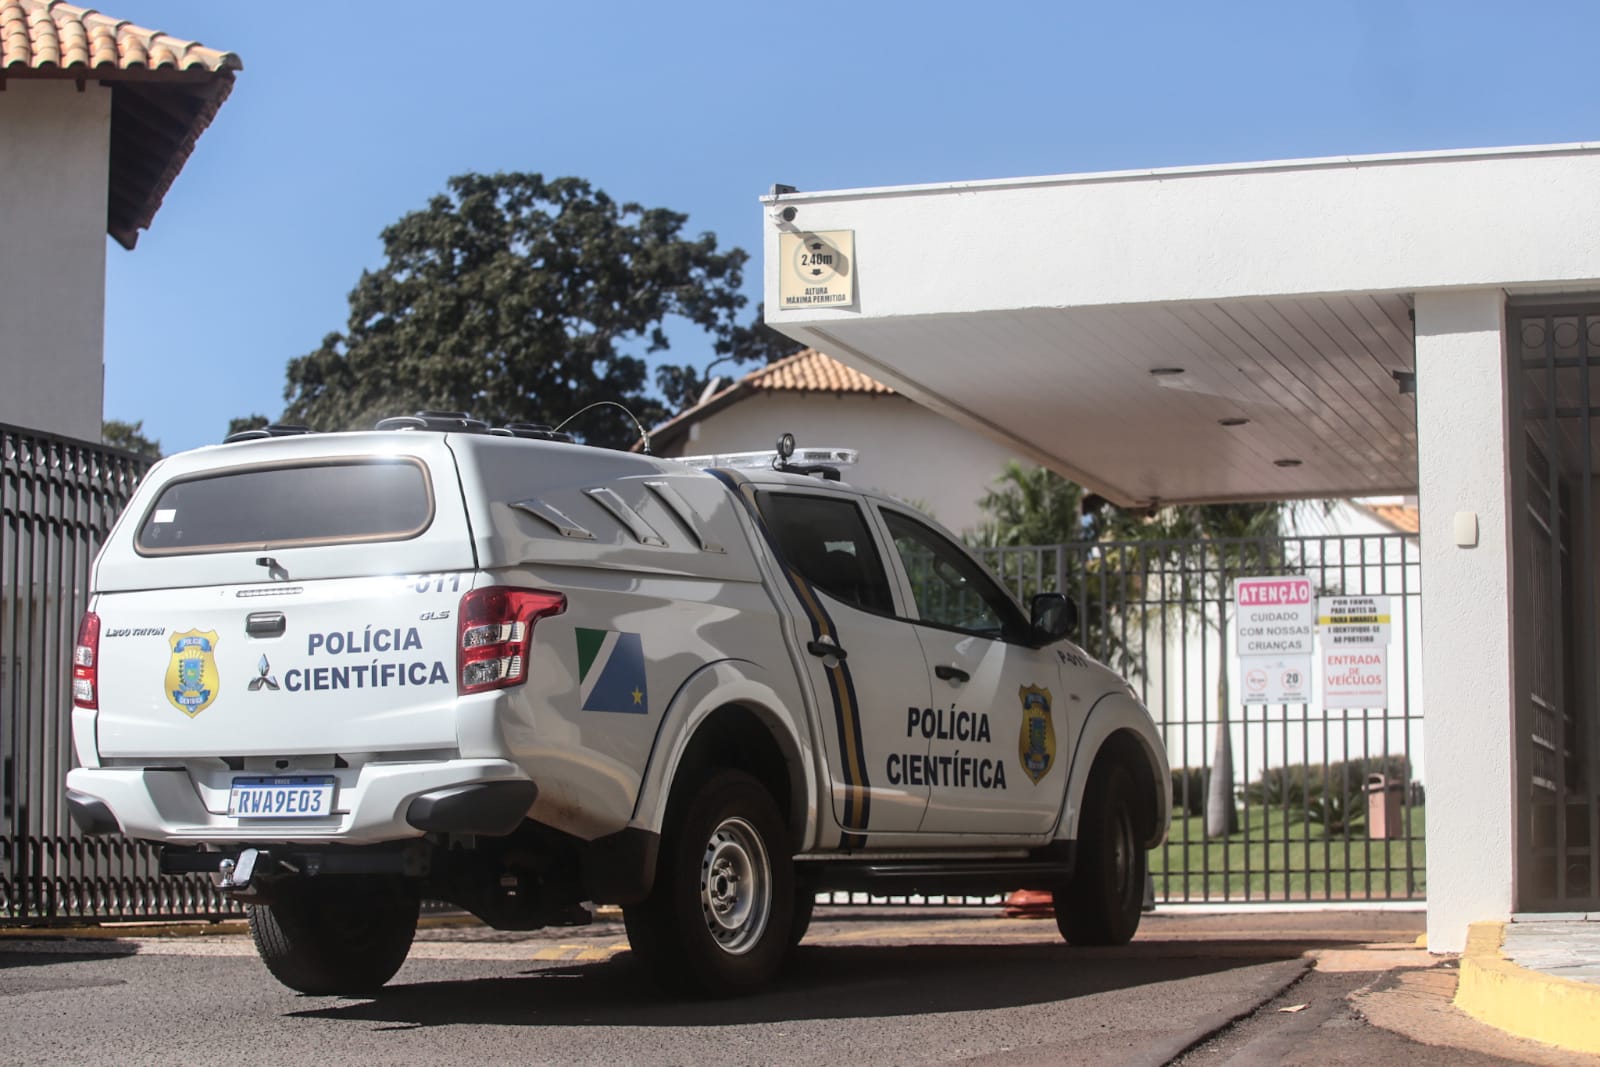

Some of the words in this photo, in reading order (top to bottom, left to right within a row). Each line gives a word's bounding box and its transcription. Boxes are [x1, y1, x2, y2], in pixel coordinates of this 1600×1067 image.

[805, 287, 828, 295] ALTURA
[786, 295, 812, 304] MÁXIMA
[813, 294, 846, 303] PERMITIDA
[1240, 583, 1308, 604] ATENÇÃO
[419, 610, 451, 621] GLS
[1347, 606, 1367, 614] ANTES
[1250, 611, 1299, 622] CUIDADO
[1330, 616, 1348, 624] FAIXA
[1349, 615, 1378, 623] AMARELA
[105, 628, 132, 637] L200
[133, 627, 165, 637] TRITON
[1240, 627, 1264, 637] COM
[1266, 626, 1310, 636] NOSSAS
[308, 624, 423, 656] POLÍCIA
[1343, 635, 1374, 643] PORTEIRO
[1248, 641, 1302, 651] CRIANÇAS
[1327, 655, 1381, 665] ENTRADA
[284, 659, 450, 692] CIENTÍFICA
[1348, 667, 1359, 675] DE
[1286, 673, 1299, 684] 20
[1327, 673, 1382, 685] VEÍCULOS
[907, 704, 991, 743] POLÍCIA
[886, 750, 1007, 789] CIENTÍFICA
[238, 789, 323, 813] RWA9E03
